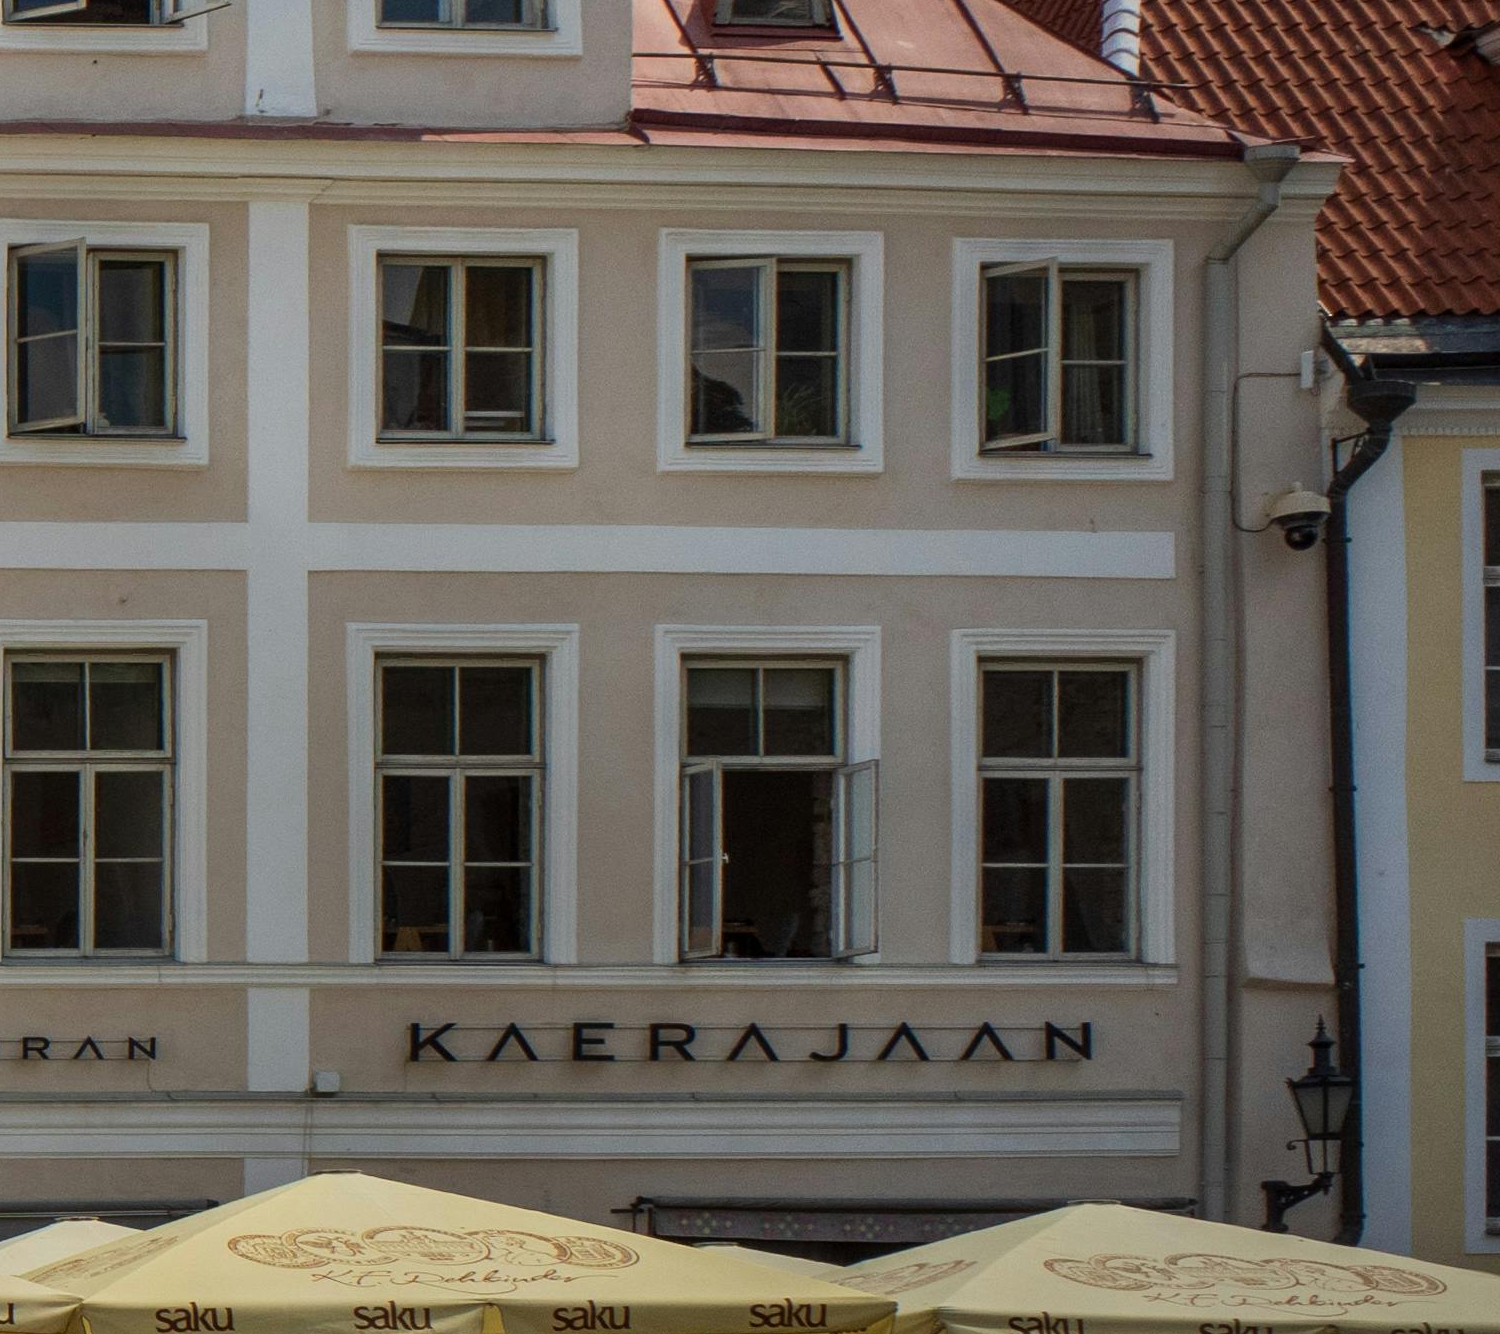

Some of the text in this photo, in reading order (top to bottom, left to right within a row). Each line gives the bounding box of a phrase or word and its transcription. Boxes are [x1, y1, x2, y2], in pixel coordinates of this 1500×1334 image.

[407, 1020, 1093, 1064] KAERAJAAN
[156, 1302, 235, 1332] saku
[354, 1300, 435, 1331] saku
[553, 1300, 630, 1331] saku
[749, 1298, 826, 1328] saku
